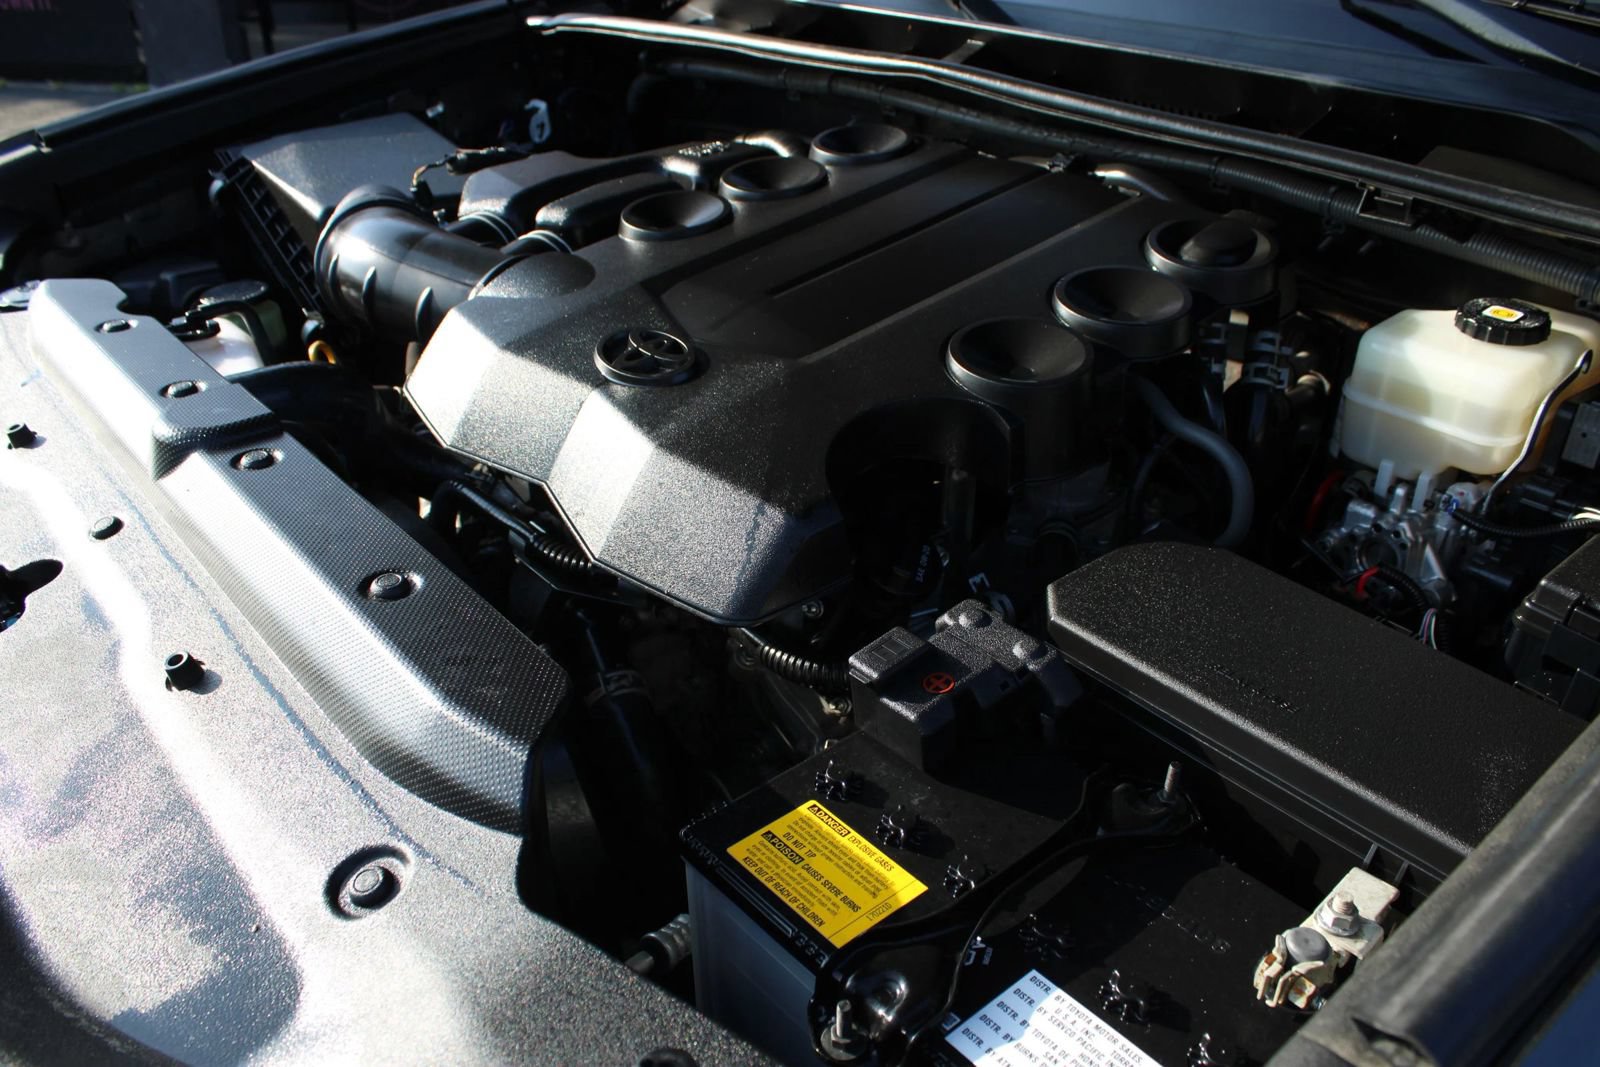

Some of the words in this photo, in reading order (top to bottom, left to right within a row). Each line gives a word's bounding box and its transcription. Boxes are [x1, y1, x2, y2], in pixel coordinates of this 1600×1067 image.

[783, 832, 794, 840] DO
[792, 839, 806, 850] NOT
[804, 849, 816, 858] TIP
[816, 811, 848, 835] DANGER
[848, 836, 876, 857] EXPLOSIVE
[875, 856, 894, 871] GASES
[743, 856, 758, 868] KEEP
[755, 866, 768, 877] OUT
[765, 875, 775, 883] OF
[772, 882, 791, 897] REACH
[788, 896, 800, 905] OF
[796, 903, 824, 926] CHILDREN
[770, 838, 802, 863] POISON
[801, 863, 824, 881] CAUSES
[821, 879, 843, 897] SEVERE
[840, 895, 861, 912] BURNS
[978, 1014, 1004, 1034] DISTR.
[1002, 1032, 1016, 1043] BY
[1014, 1041, 1041, 1062] BURNS
[995, 1001, 1021, 1020] DISTR.
[1019, 1018, 1031, 1029] BY
[1031, 1028, 1060, 1050] TOYOTA
[1058, 1049, 1071, 1059] DE
[1013, 988, 1037, 1007] DISTR.
[1036, 1006, 1048, 1015] BY
[1048, 1015, 1077, 1037] SERVCO
[1076, 1036, 1106, 1060] PACIFIC
[1029, 975, 1053, 994] DISTR.
[1054, 994, 1066, 1004] BY
[1066, 1003, 1093, 1024] TOYOTA
[1093, 1024, 1119, 1044] MOTOR
[961, 1027, 987, 1048] DISTR.
[985, 1046, 998, 1056] BY
[1043, 1051, 1059, 1064] SAN
